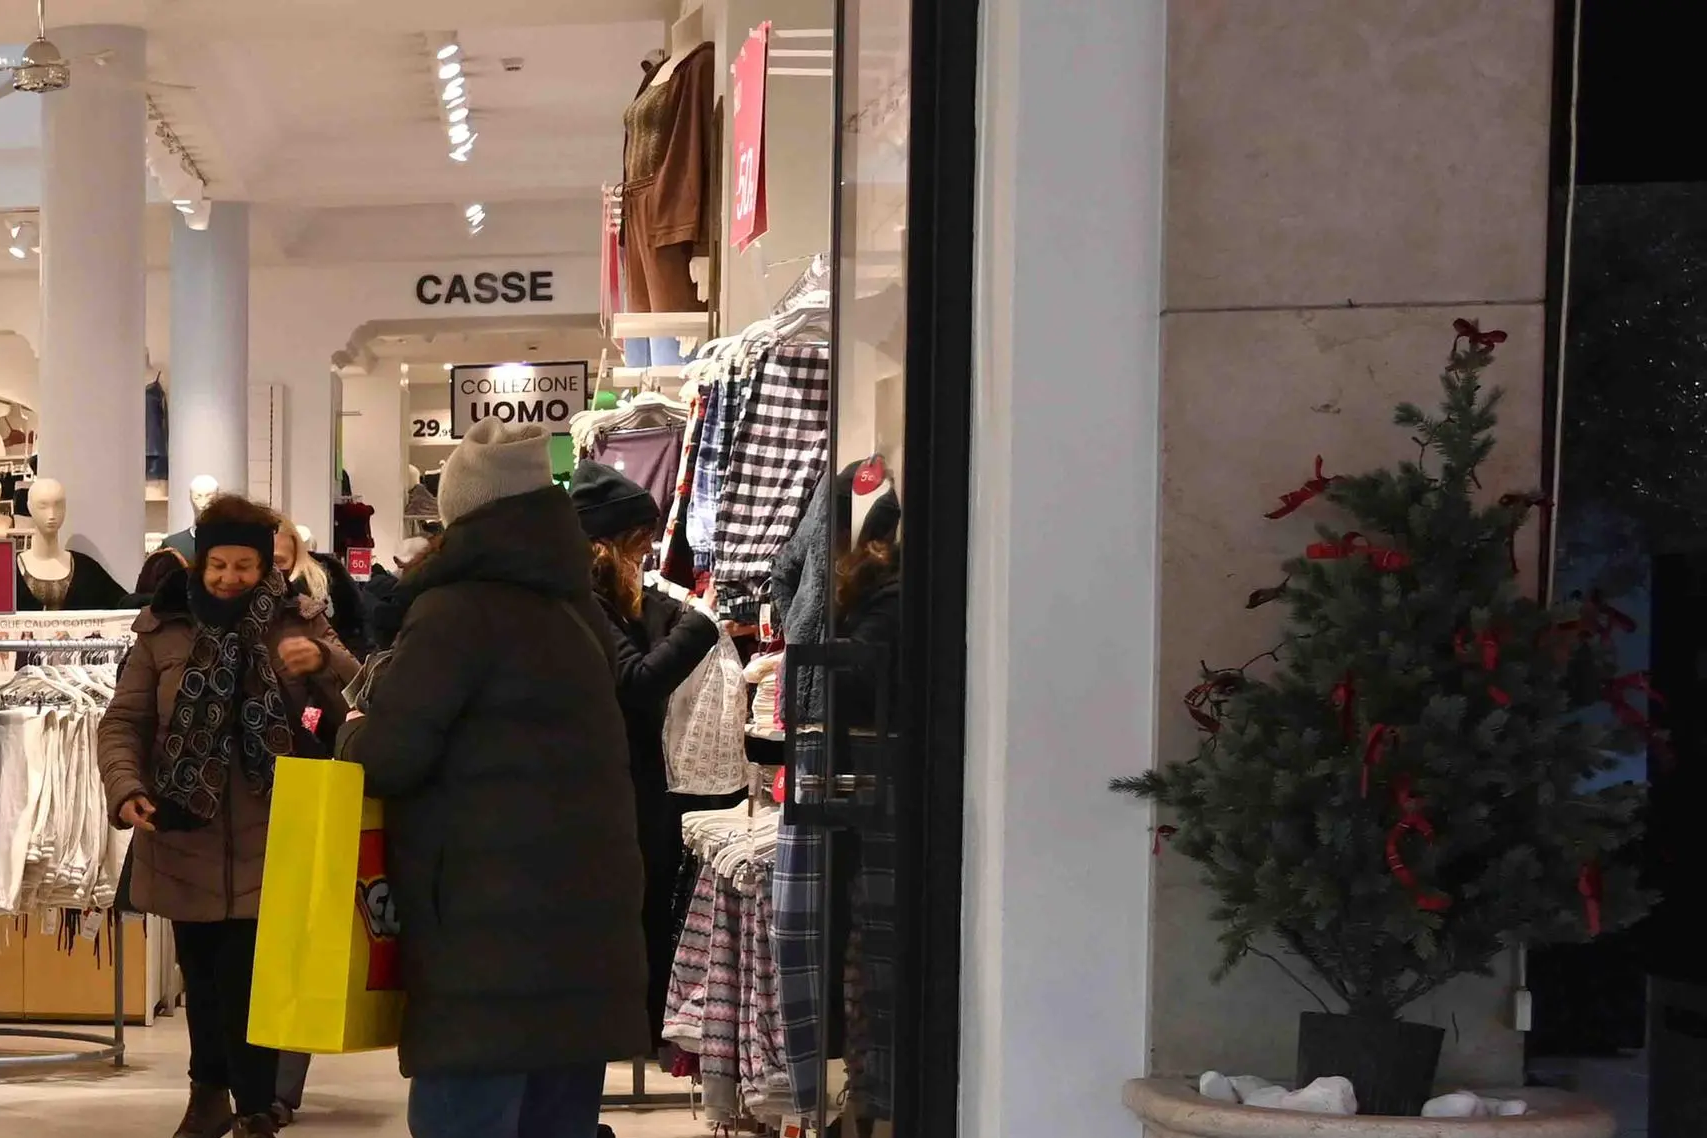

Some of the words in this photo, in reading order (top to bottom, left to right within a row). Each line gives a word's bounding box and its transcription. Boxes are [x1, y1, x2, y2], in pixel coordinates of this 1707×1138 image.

[416, 271, 553, 305] CASSE
[461, 376, 579, 395] COLLEZIONE
[470, 399, 569, 423] UOMO
